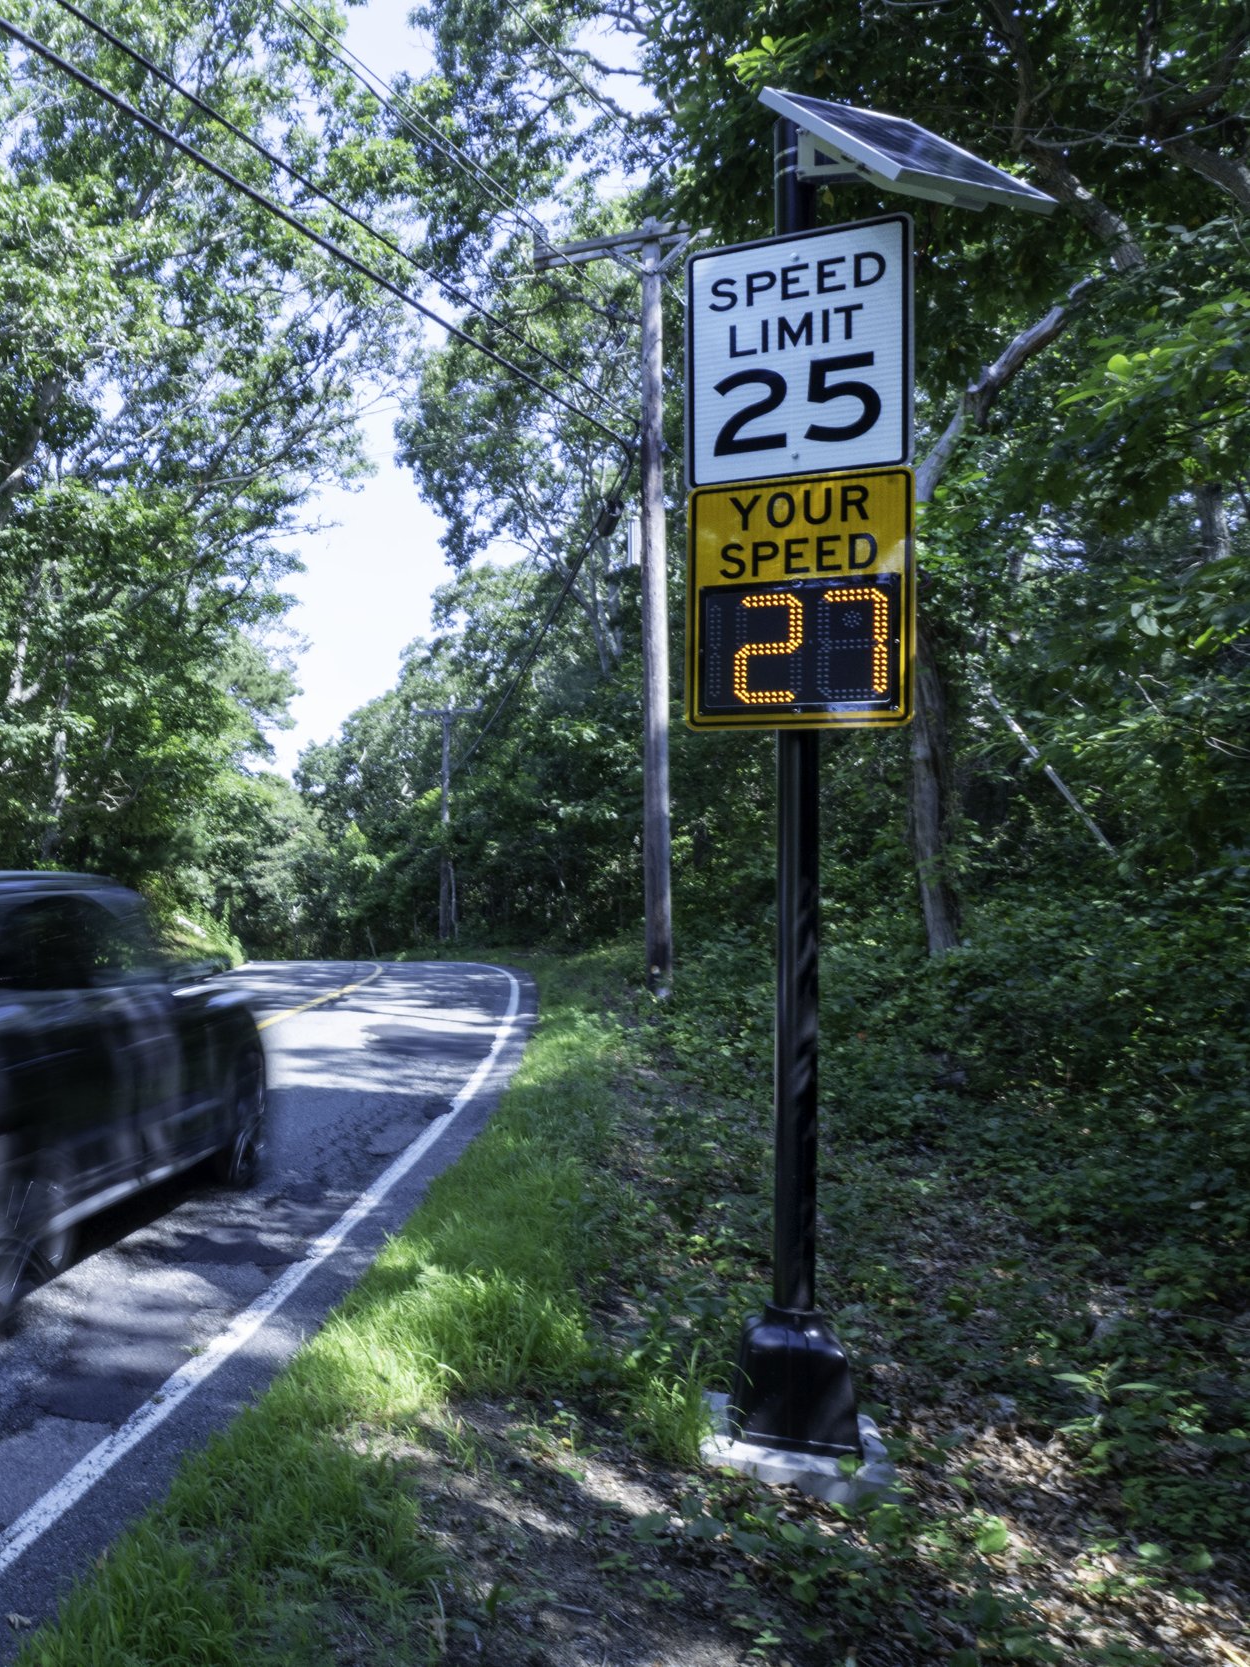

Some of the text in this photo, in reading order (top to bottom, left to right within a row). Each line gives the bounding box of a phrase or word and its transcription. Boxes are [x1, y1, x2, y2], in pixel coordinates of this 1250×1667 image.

[708, 251, 886, 312] SPEED
[729, 303, 864, 359] LIMIT
[713, 351, 882, 457] 25
[729, 484, 870, 531] YOUR
[719, 532, 878, 579] SPEED
[733, 587, 888, 704] 27
